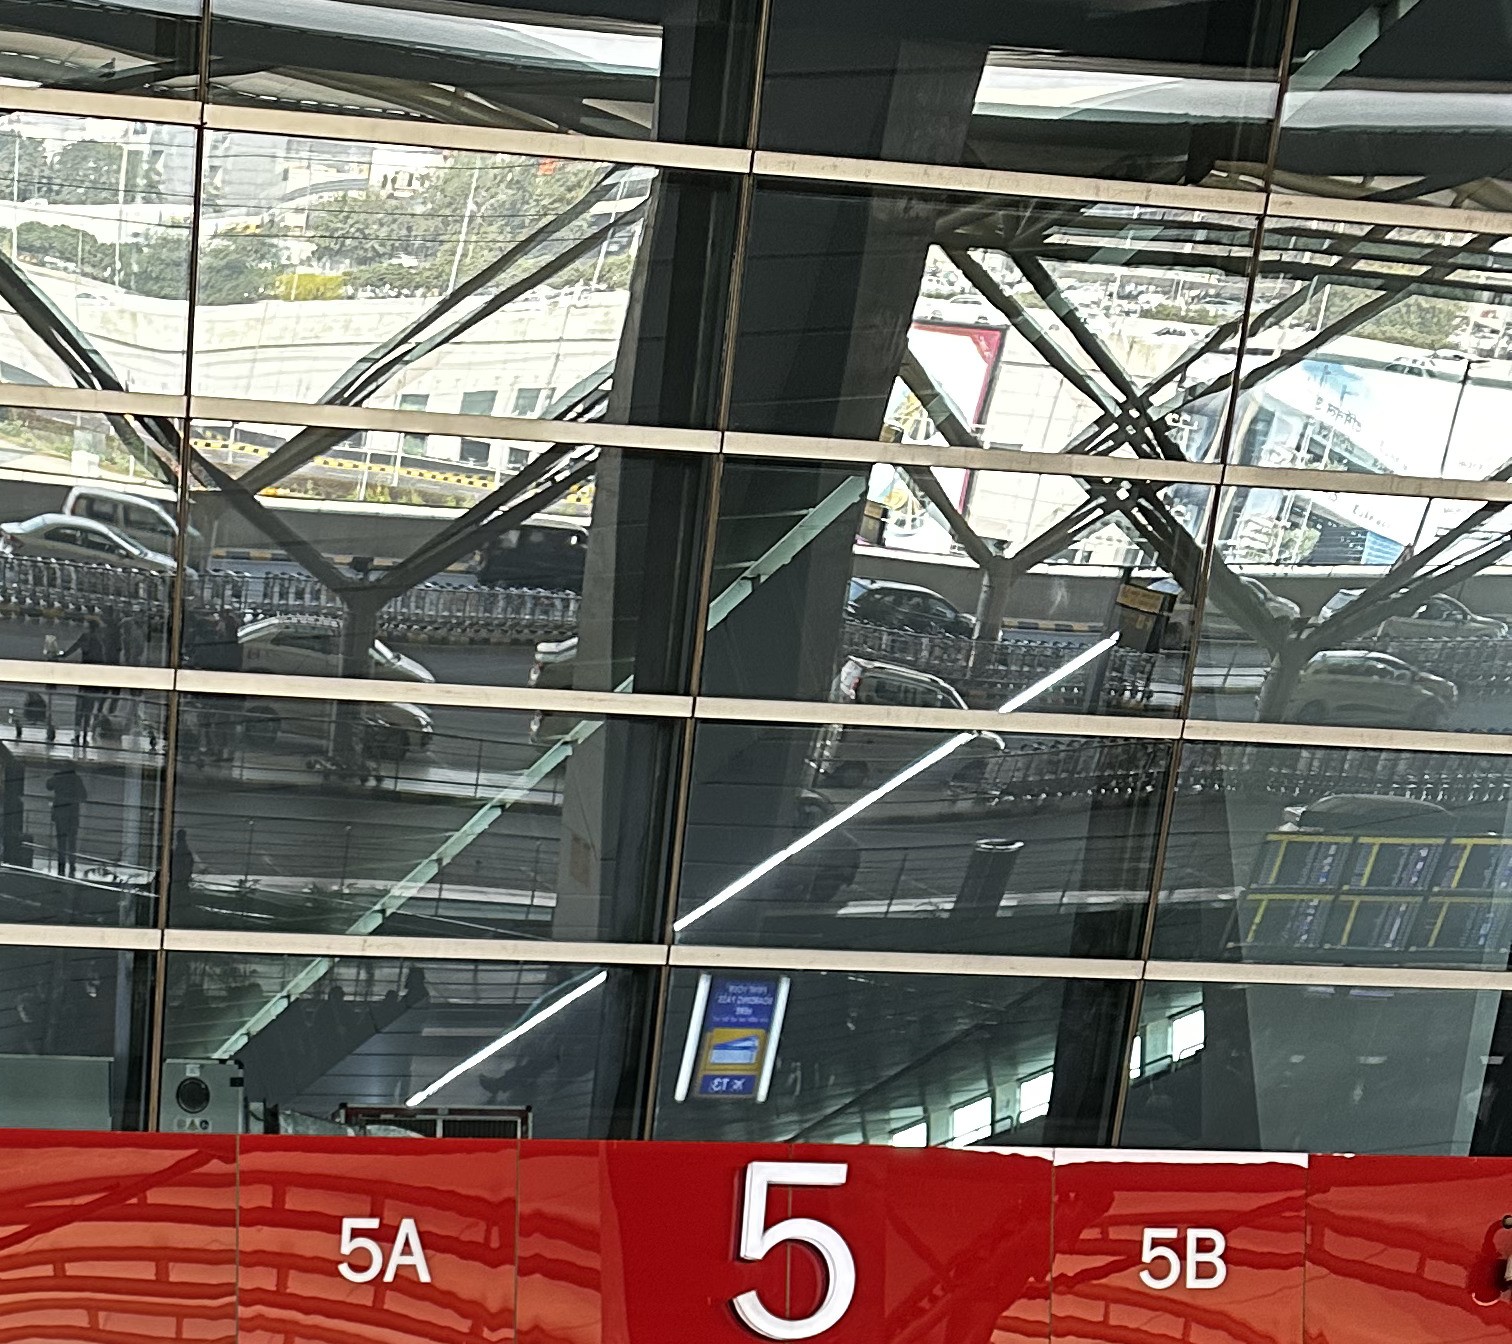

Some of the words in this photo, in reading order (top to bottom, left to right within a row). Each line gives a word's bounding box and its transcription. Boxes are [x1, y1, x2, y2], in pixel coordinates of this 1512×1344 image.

[337, 1217, 432, 1284] 5A
[732, 1160, 857, 1340] 5
[1138, 1226, 1228, 1290] 5B
